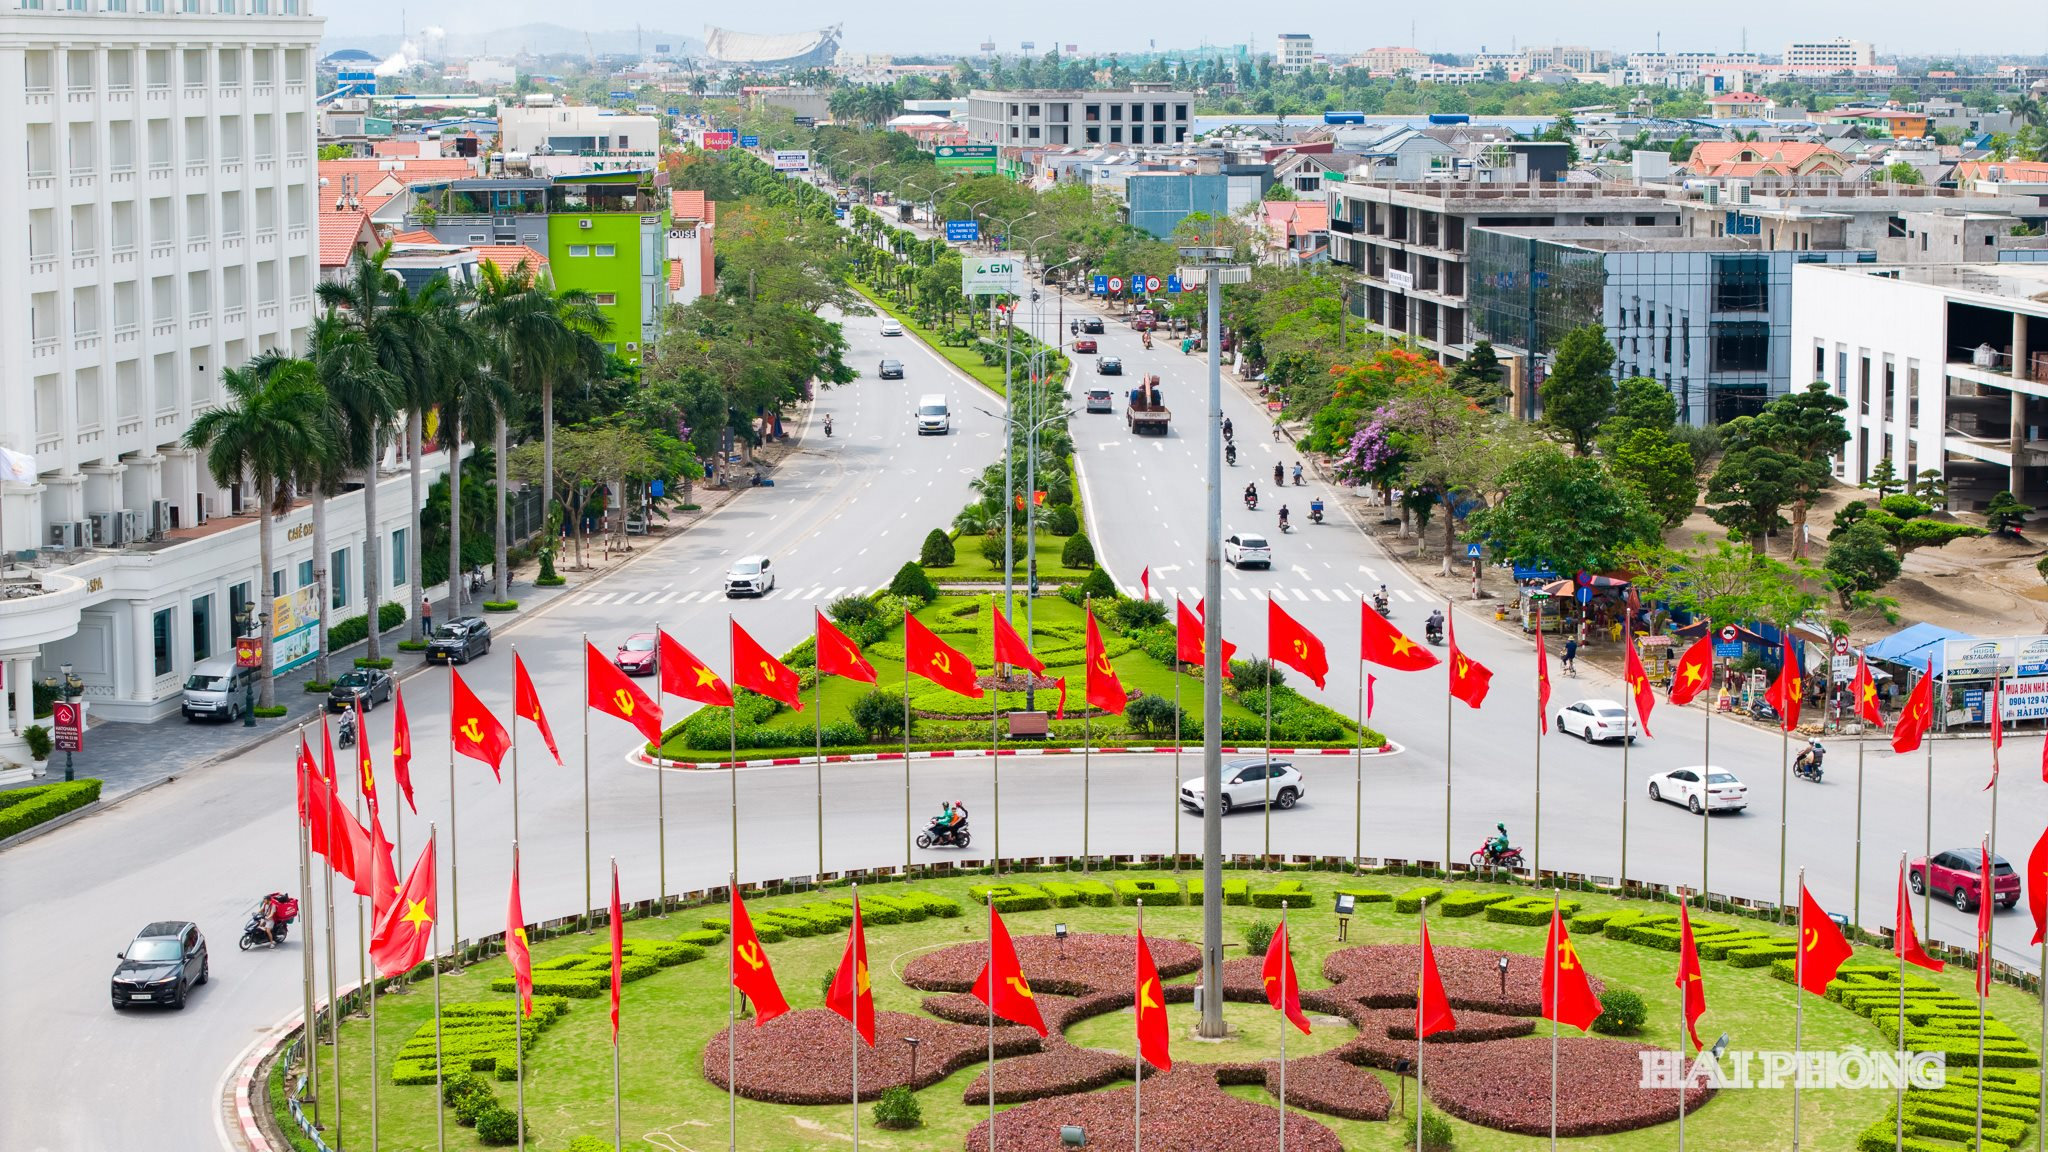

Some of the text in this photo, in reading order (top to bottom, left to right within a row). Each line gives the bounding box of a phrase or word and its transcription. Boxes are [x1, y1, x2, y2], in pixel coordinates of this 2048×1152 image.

[991, 264, 1013, 273] GM
[2006, 684, 2019, 695] MUA
[2019, 681, 2032, 695] BÁN
[2009, 697, 2026, 706] 0904
[2028, 696, 2039, 705] 129
